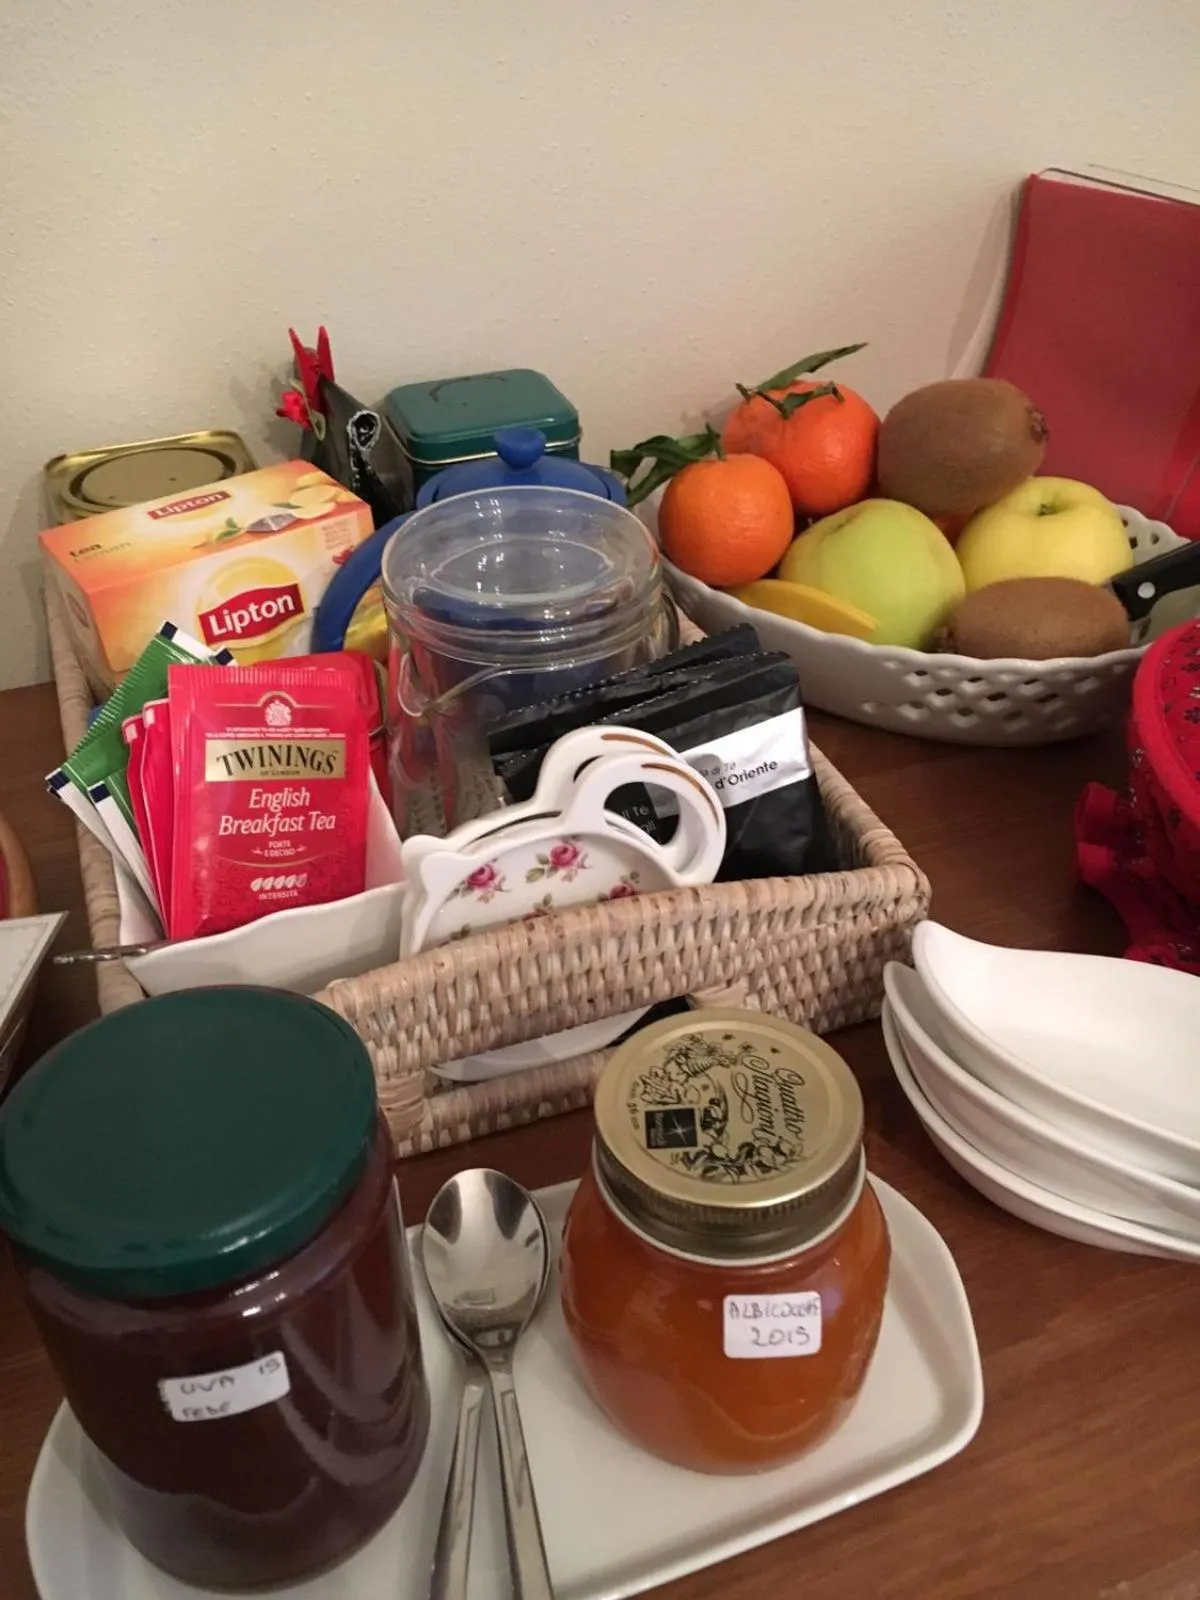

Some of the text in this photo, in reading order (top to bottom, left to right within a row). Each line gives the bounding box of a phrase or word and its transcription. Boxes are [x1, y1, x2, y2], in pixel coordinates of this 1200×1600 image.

[156, 494, 223, 516] Lipton
[209, 594, 296, 636] Lipton
[216, 744, 339, 776] TWININGS
[714, 760, 778, 790] d'Oriente
[248, 787, 310, 812] English
[218, 811, 337, 838] Breakfast Tea
[774, 1067, 806, 1141] Quattro
[180, 1375, 235, 1395] UVA
